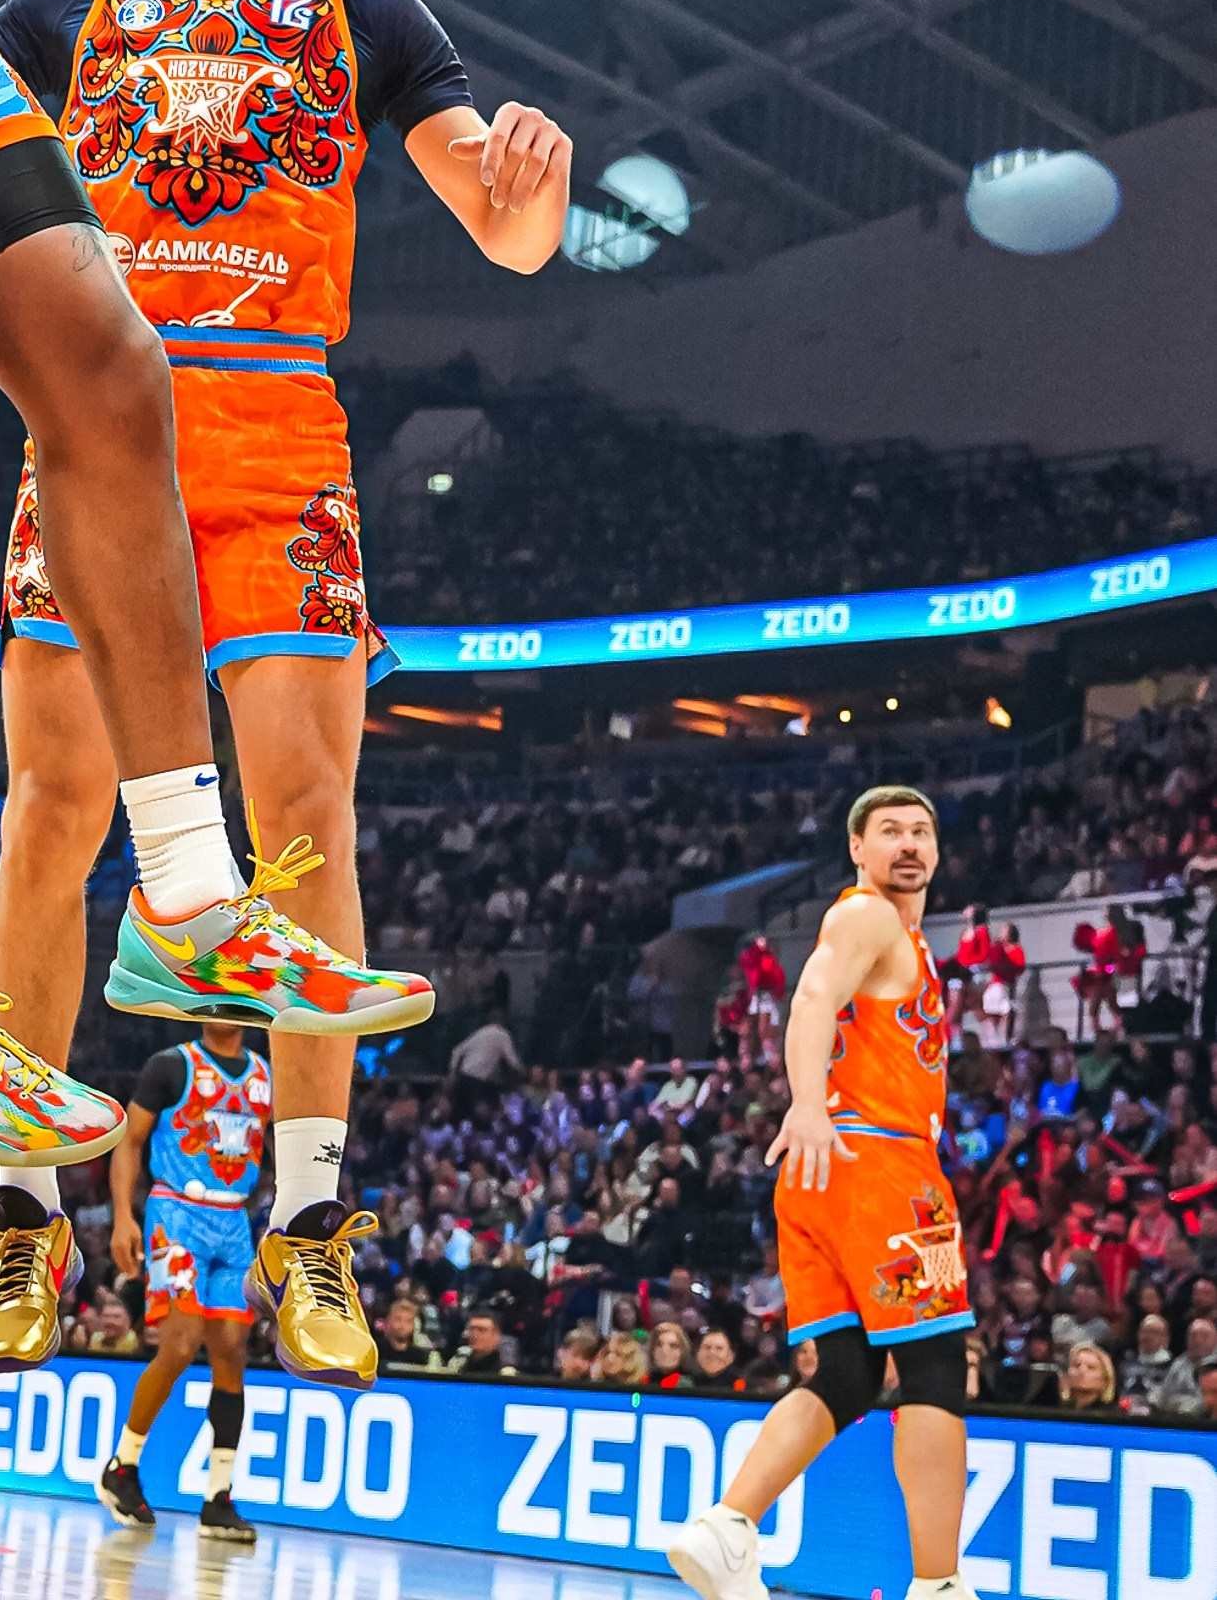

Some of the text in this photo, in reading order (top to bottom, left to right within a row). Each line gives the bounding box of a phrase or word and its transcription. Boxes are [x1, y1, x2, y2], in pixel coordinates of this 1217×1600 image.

[167, 60, 248, 82] HOZYAEVA
[137, 239, 289, 275] КАМКАБЕЛЬ
[325, 582, 362, 606] ZEDO
[1089, 555, 1171, 602] ZEDO
[761, 603, 851, 641] ZEDO
[928, 587, 1017, 627] ZEDO
[458, 629, 543, 662] ZEDO
[610, 615, 692, 653] ZEDO
[178, 1381, 414, 1522] ZEDO
[956, 1437, 1217, 1600] ZED
